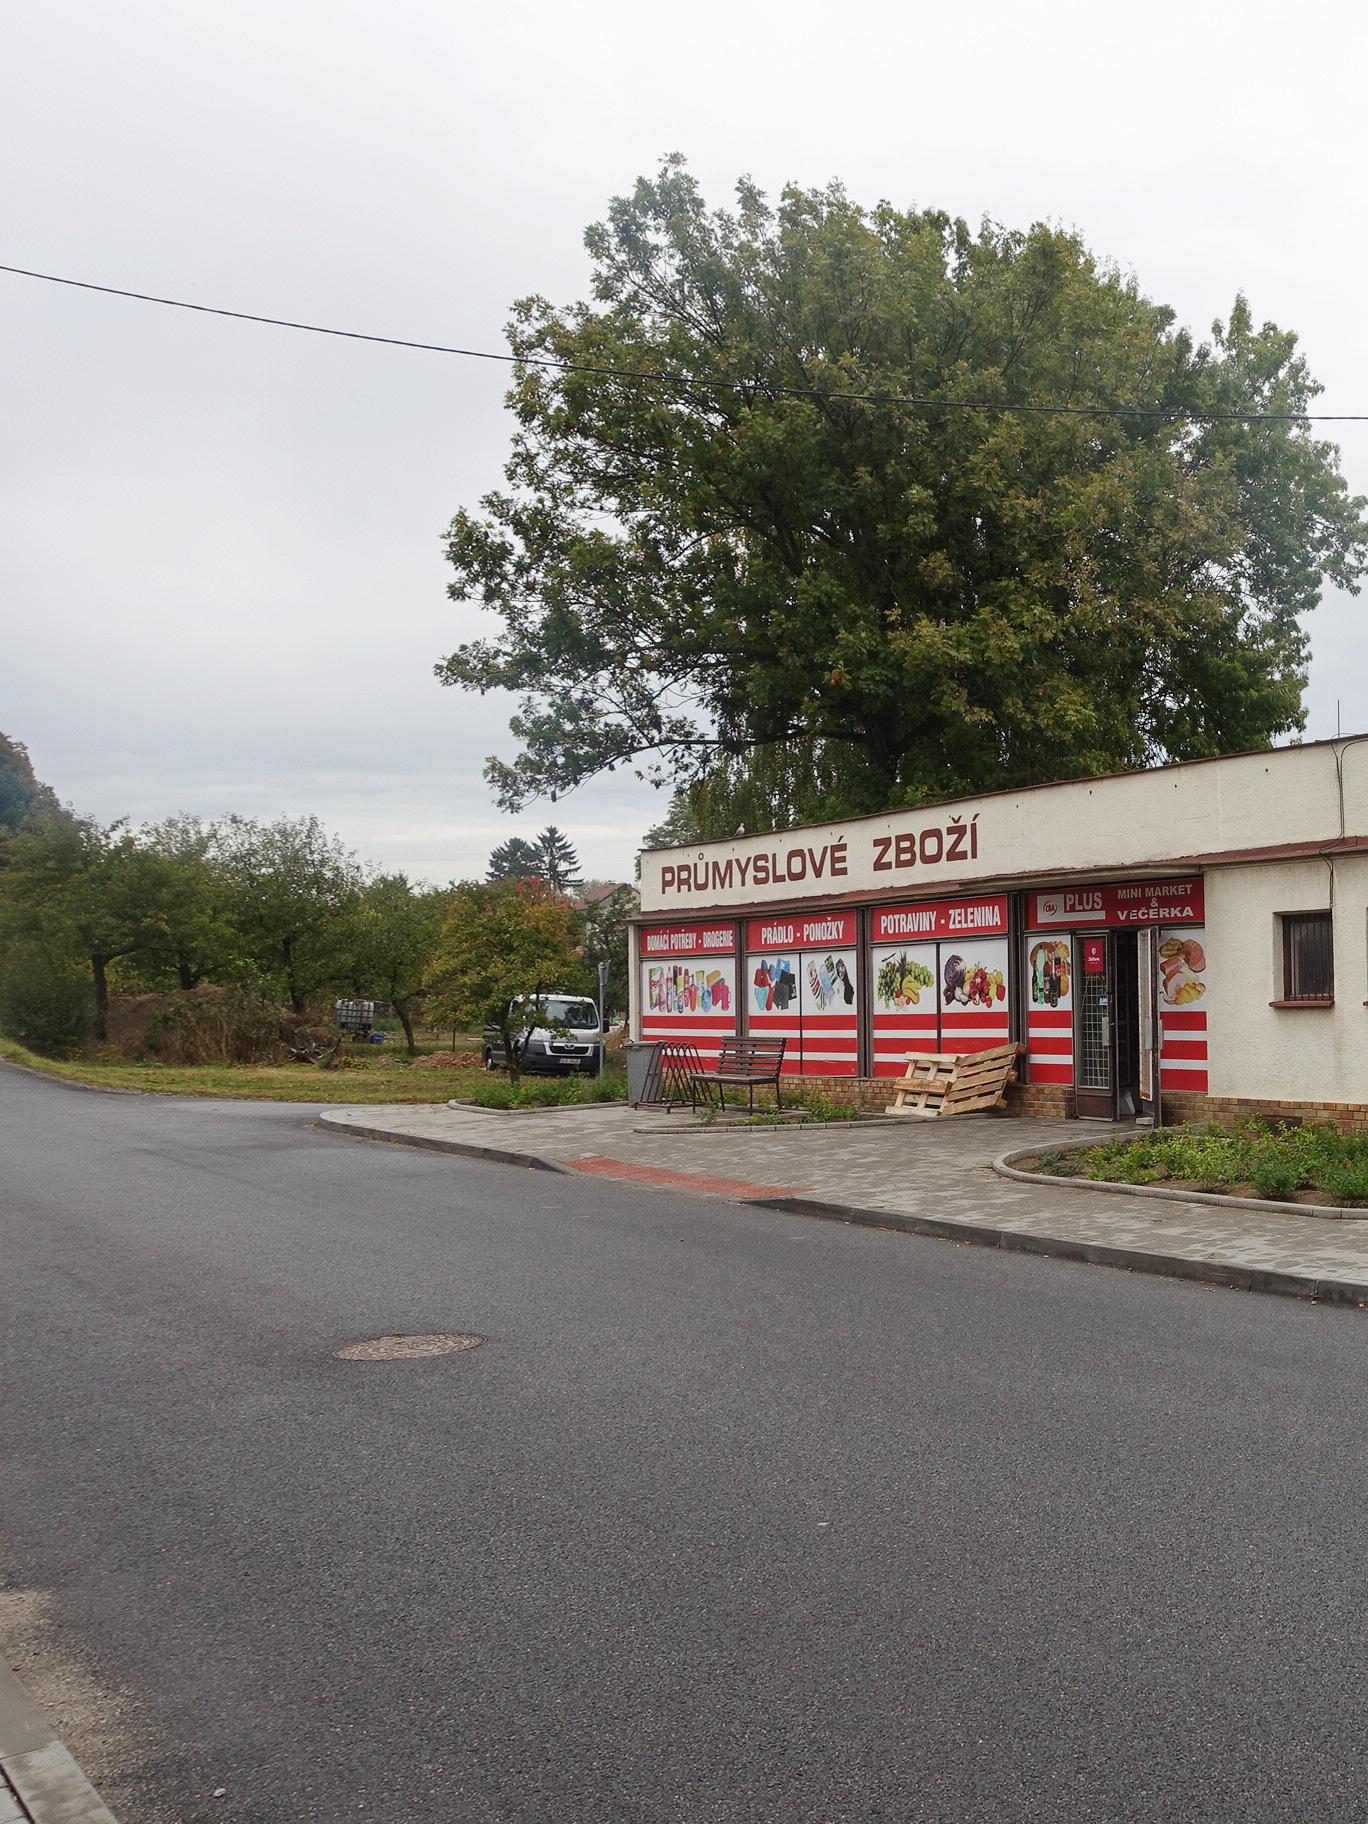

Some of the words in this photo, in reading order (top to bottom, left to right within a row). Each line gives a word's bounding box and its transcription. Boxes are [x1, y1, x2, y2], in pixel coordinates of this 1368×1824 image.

[662, 836, 848, 894] PRŮMYSLOVÉ
[873, 813, 980, 871] ZBOŽÍ
[1066, 892, 1103, 911] PLUS
[1118, 889, 1142, 900] MINI
[1145, 884, 1193, 897] MARKET
[1151, 898, 1159, 908] &
[880, 911, 937, 935] POTRAVINY
[948, 905, 1001, 929] ZELENINA
[1117, 906, 1194, 921] VEČERKA
[647, 930, 669, 951] DOMÁCÍ
[670, 929, 697, 949] POTŘEBY
[703, 930, 733, 948] DROGERIE
[761, 921, 793, 944] PRÁDLO
[803, 916, 844, 942] PONOŽKY
